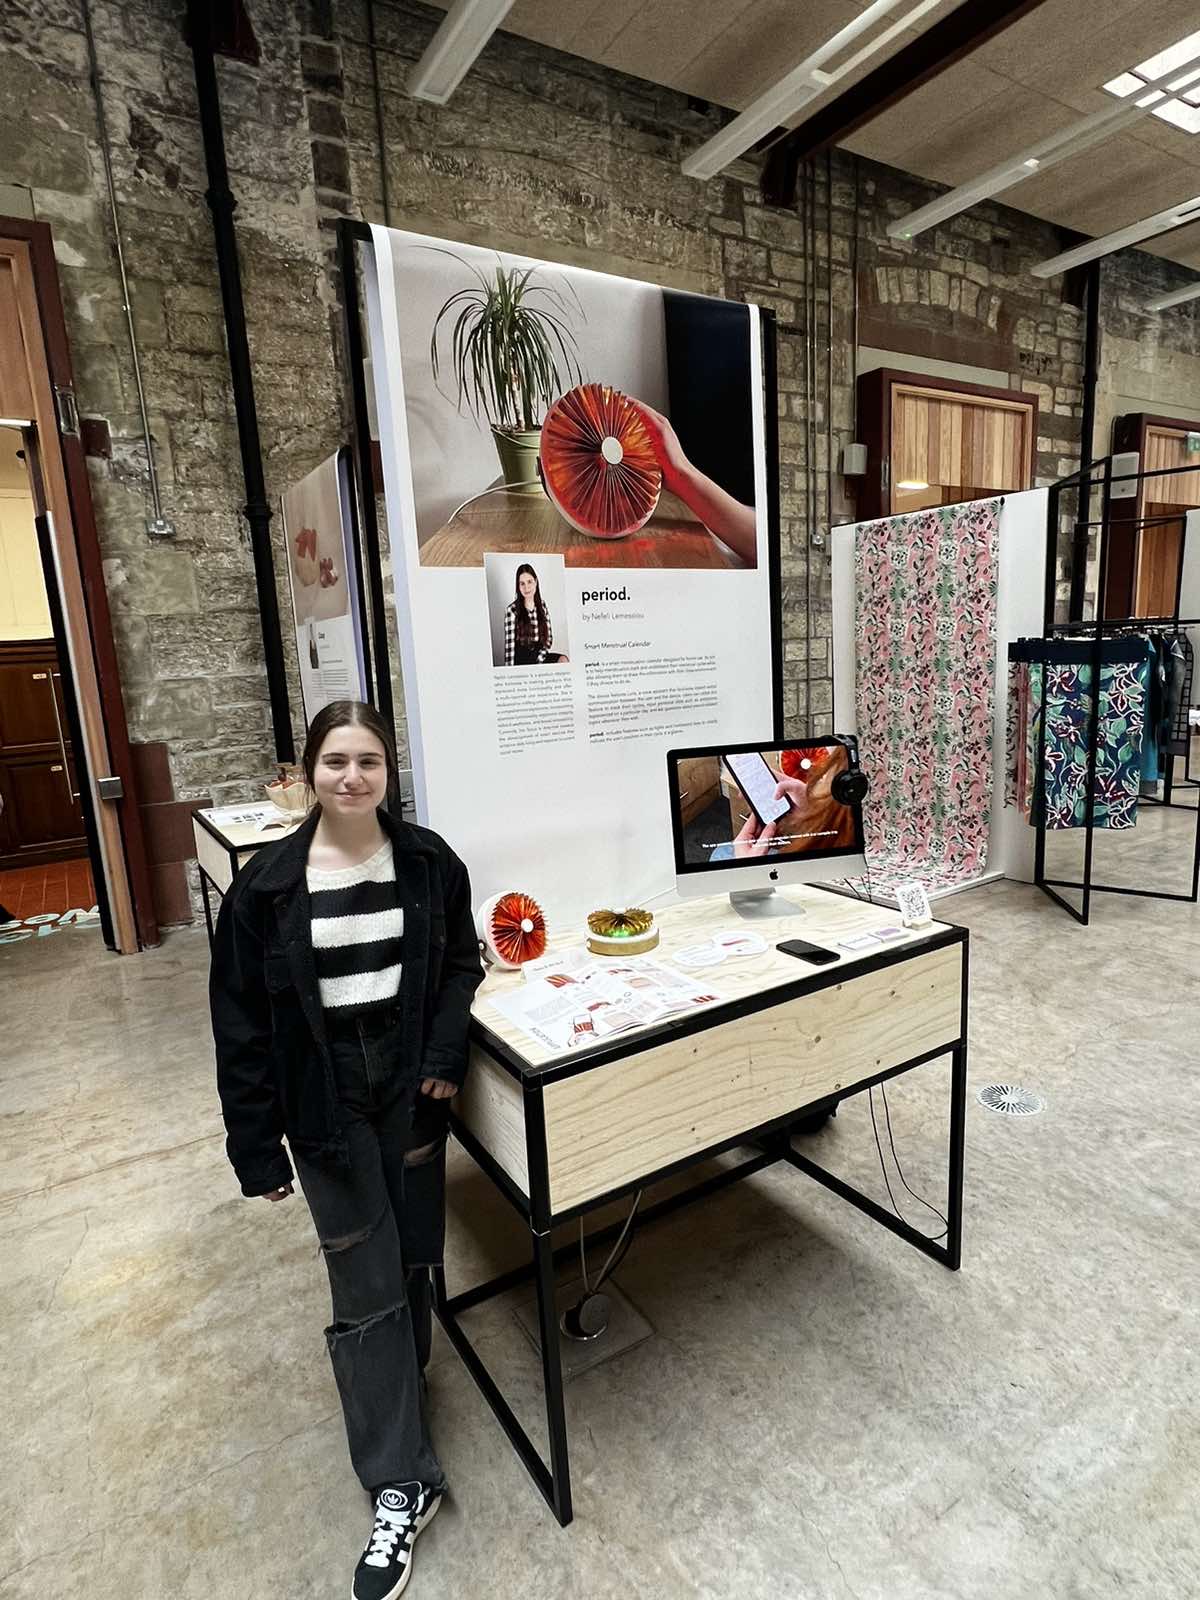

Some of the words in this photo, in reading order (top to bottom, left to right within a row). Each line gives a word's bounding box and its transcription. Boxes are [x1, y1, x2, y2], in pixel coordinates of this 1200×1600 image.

[581, 586, 631, 606] period.
[582, 613, 591, 622] by
[584, 642, 601, 650] Smart
[601, 641, 628, 649] Menstrual
[628, 640, 652, 648] Calendar
